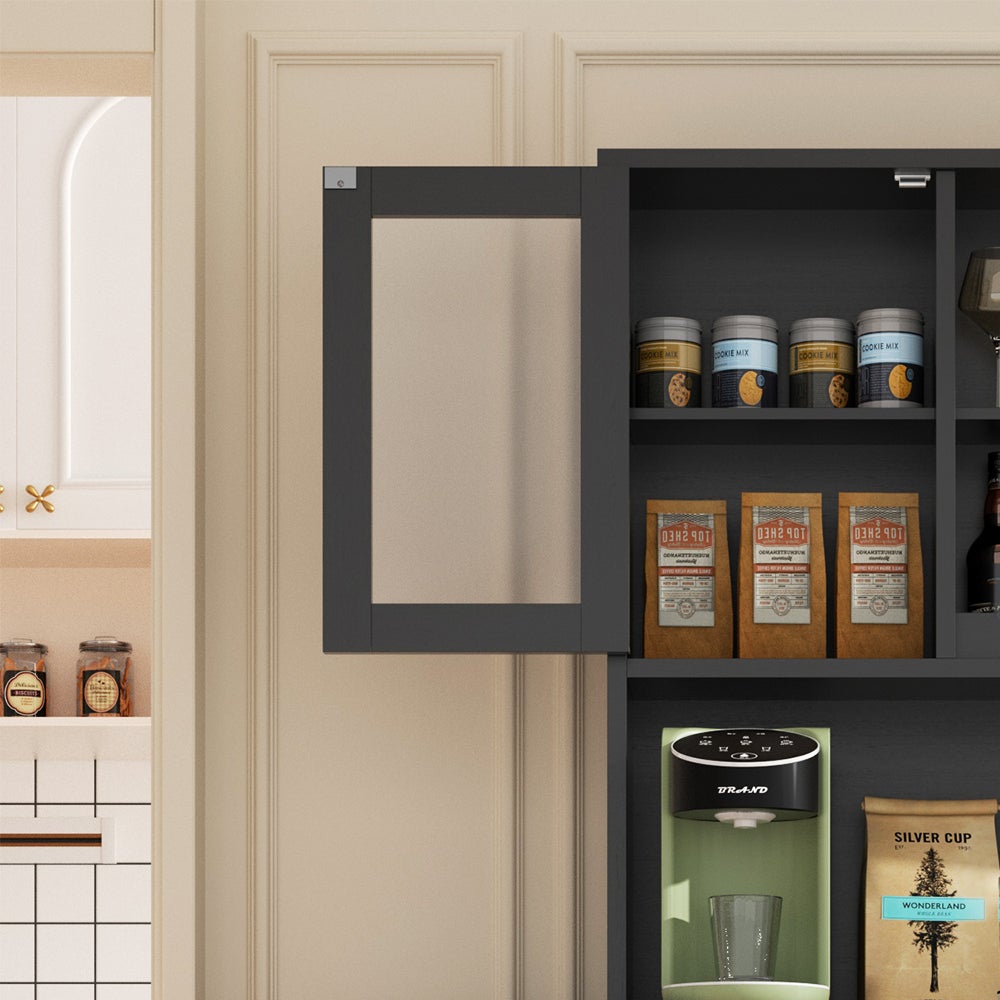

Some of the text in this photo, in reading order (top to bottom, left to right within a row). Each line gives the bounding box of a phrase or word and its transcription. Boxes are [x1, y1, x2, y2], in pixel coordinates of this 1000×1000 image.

[862, 342, 900, 352] COOKIE MIX
[665, 351, 679, 359] MIX
[736, 348, 750, 357] MIX
[799, 352, 838, 361] COOKIE MIX
[717, 786, 769, 794] BRAND
[894, 832, 972, 843] SILVER CUP
[902, 902, 966, 910] WONDERLAND
